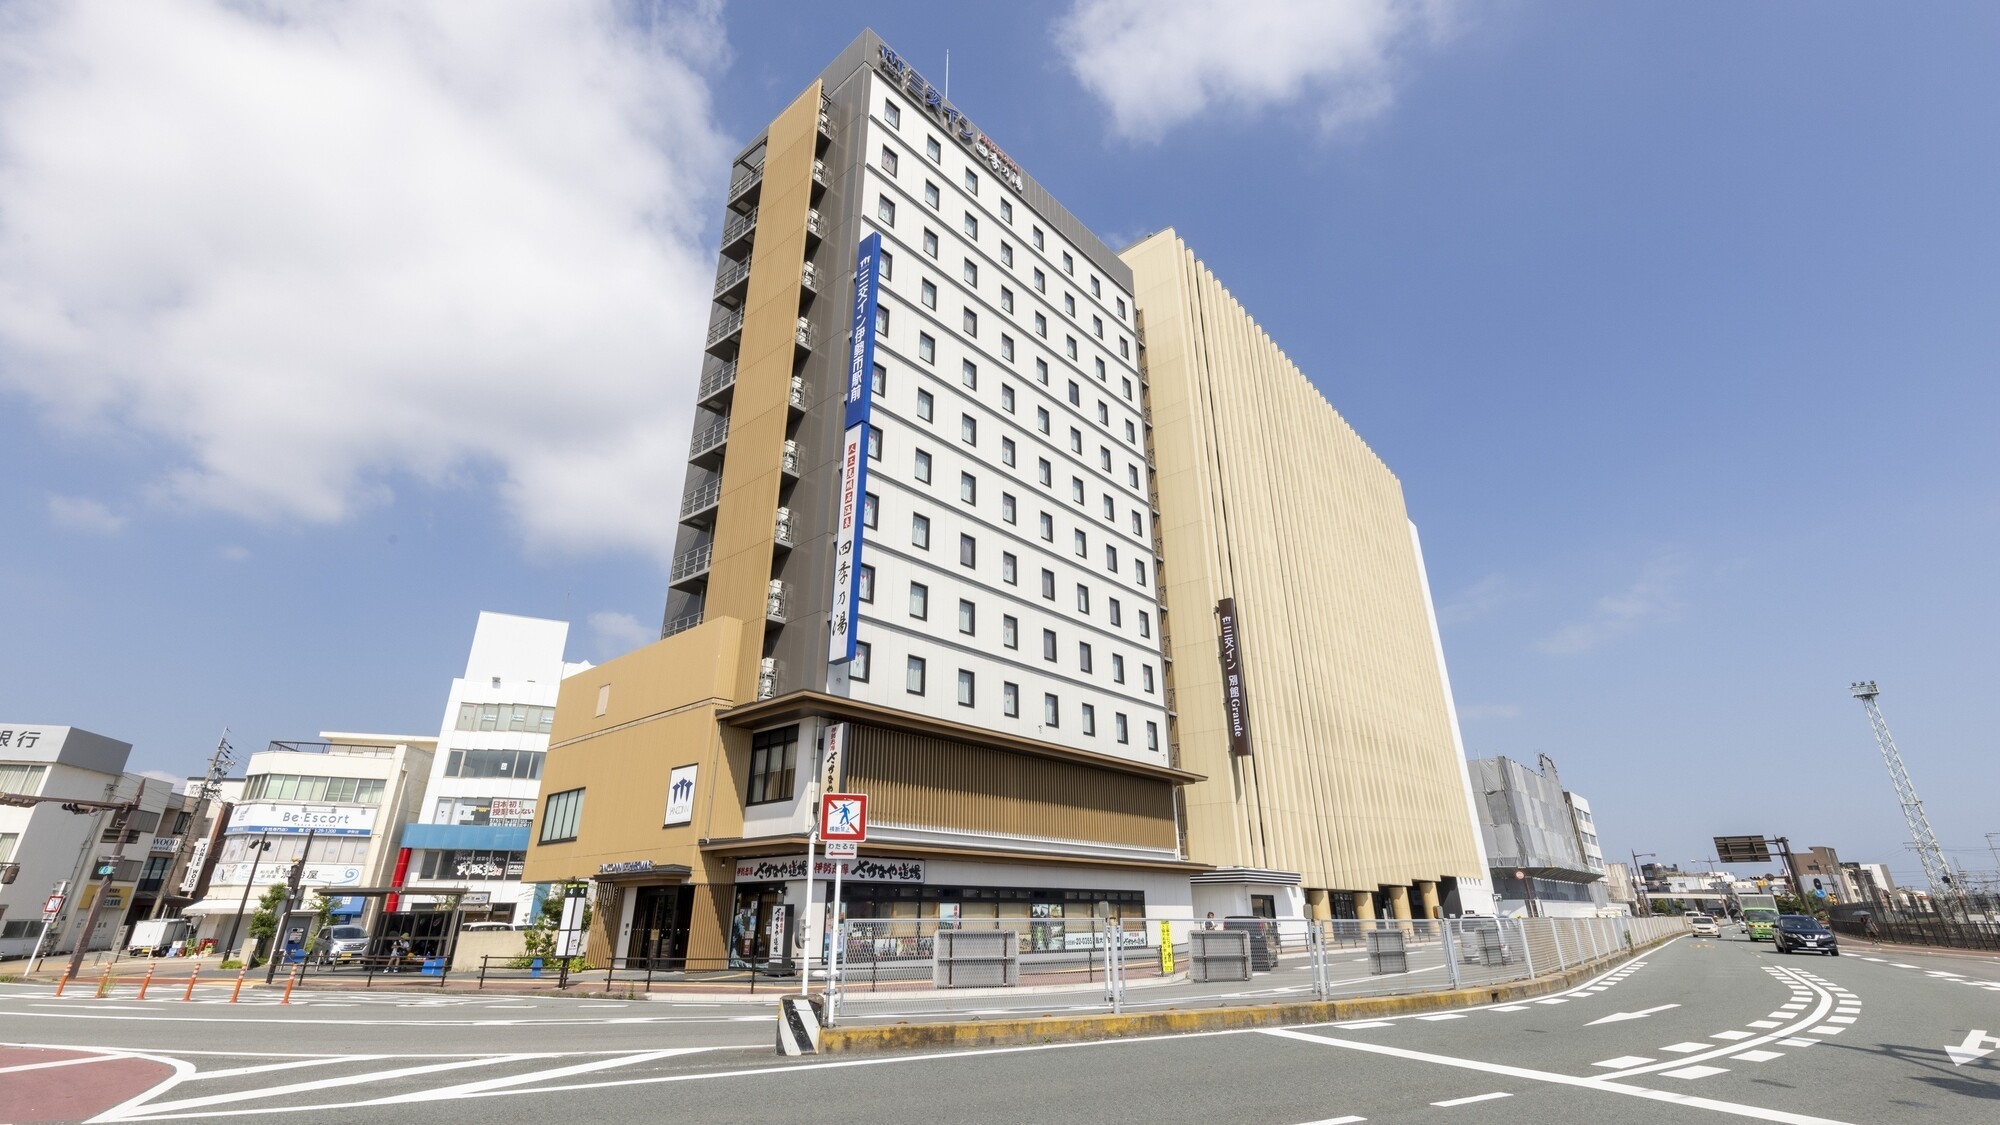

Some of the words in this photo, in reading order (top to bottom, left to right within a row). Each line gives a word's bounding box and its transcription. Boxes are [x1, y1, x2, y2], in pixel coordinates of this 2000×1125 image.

[832, 540, 852, 636] 四季乃湯
[1223, 625, 1237, 671] 三交イン
[1231, 699, 1242, 737] Grande
[851, 860, 922, 880] さかなや道場
